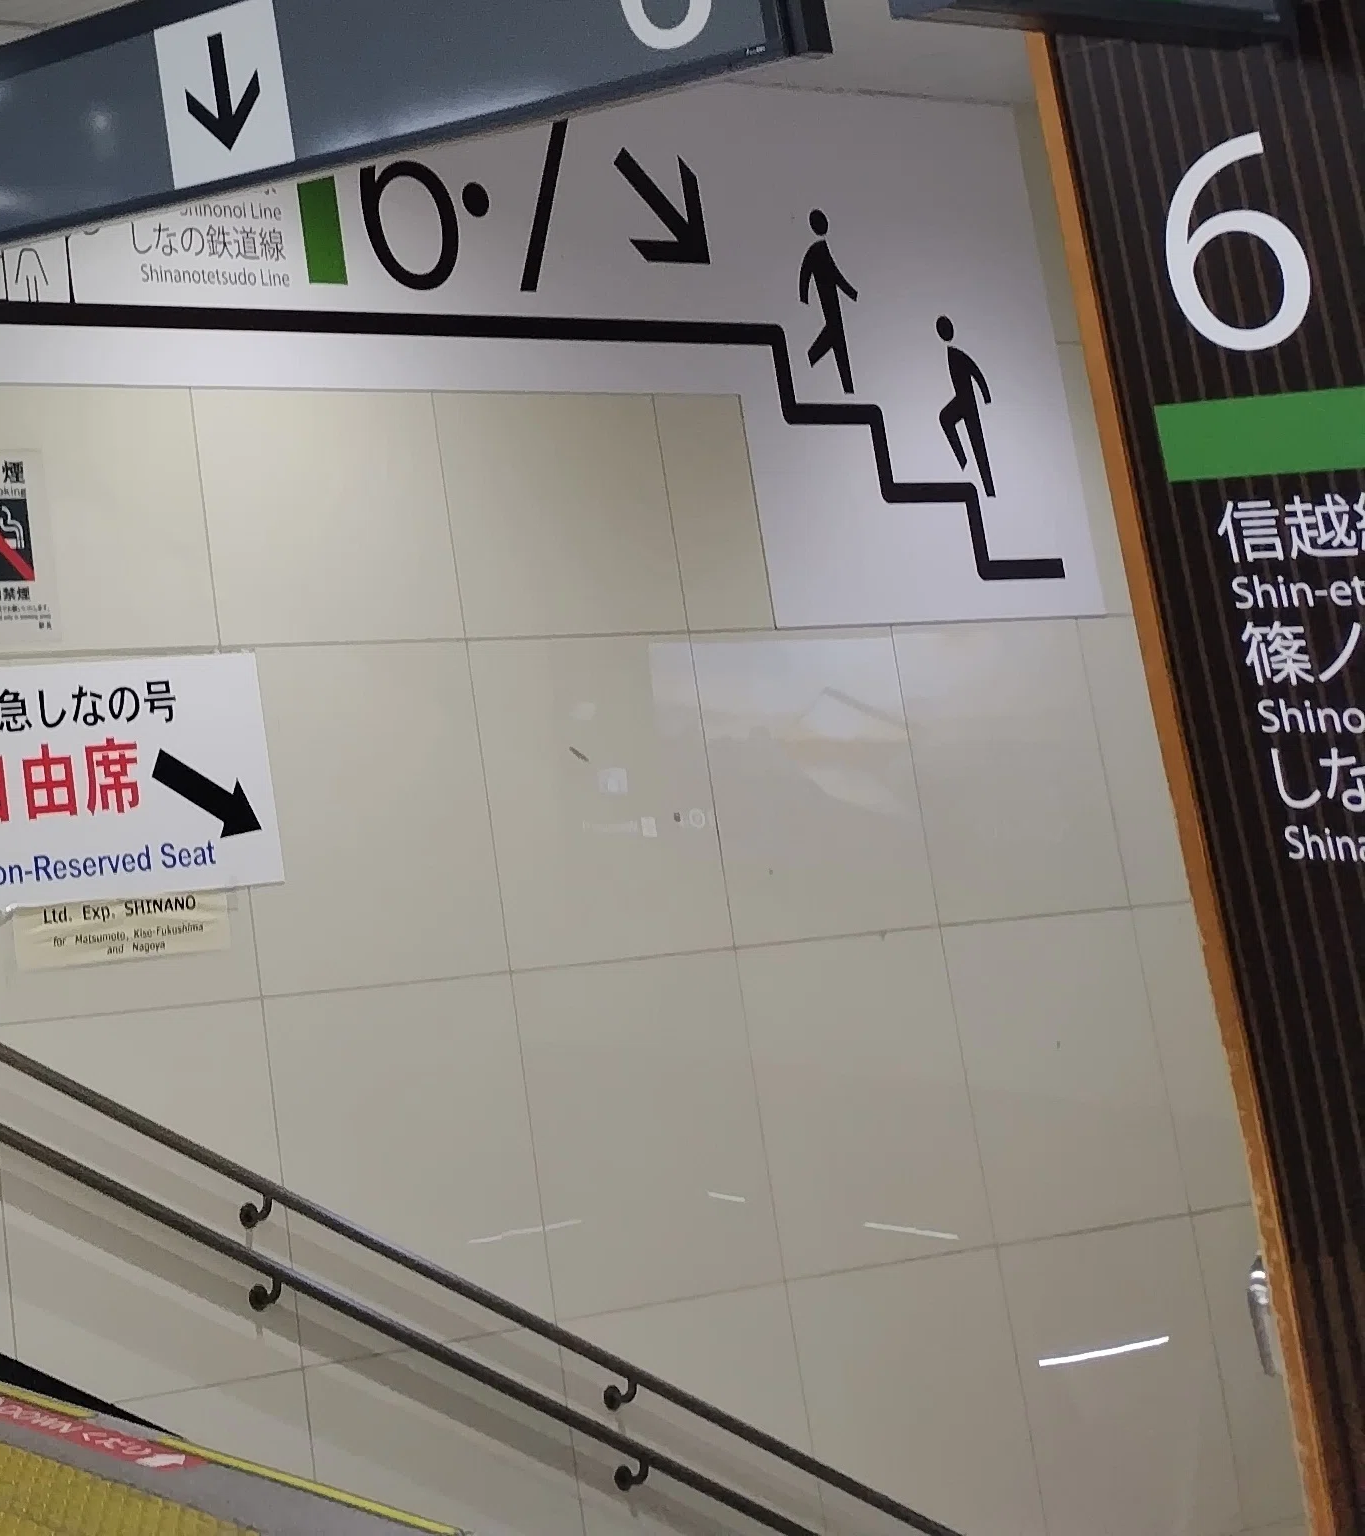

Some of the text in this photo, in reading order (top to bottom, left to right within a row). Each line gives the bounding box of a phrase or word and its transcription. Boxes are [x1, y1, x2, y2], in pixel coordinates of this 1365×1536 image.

[251, 202, 282, 222] Line
[130, 222, 287, 262] しなの鉄道線
[1165, 130, 1312, 352] 6
[140, 263, 291, 288] Shinanotetsudo Line
[1218, 492, 1365, 564] 信越
[1241, 620, 1362, 687] 篠ノ
[161, 839, 217, 868] Seat
[44, 895, 196, 924] Ltd. Exp. SHINANO
[53, 923, 203, 947] for Matsumoto, Kiso-Fukushima
[107, 941, 165, 955] and Nagoya
